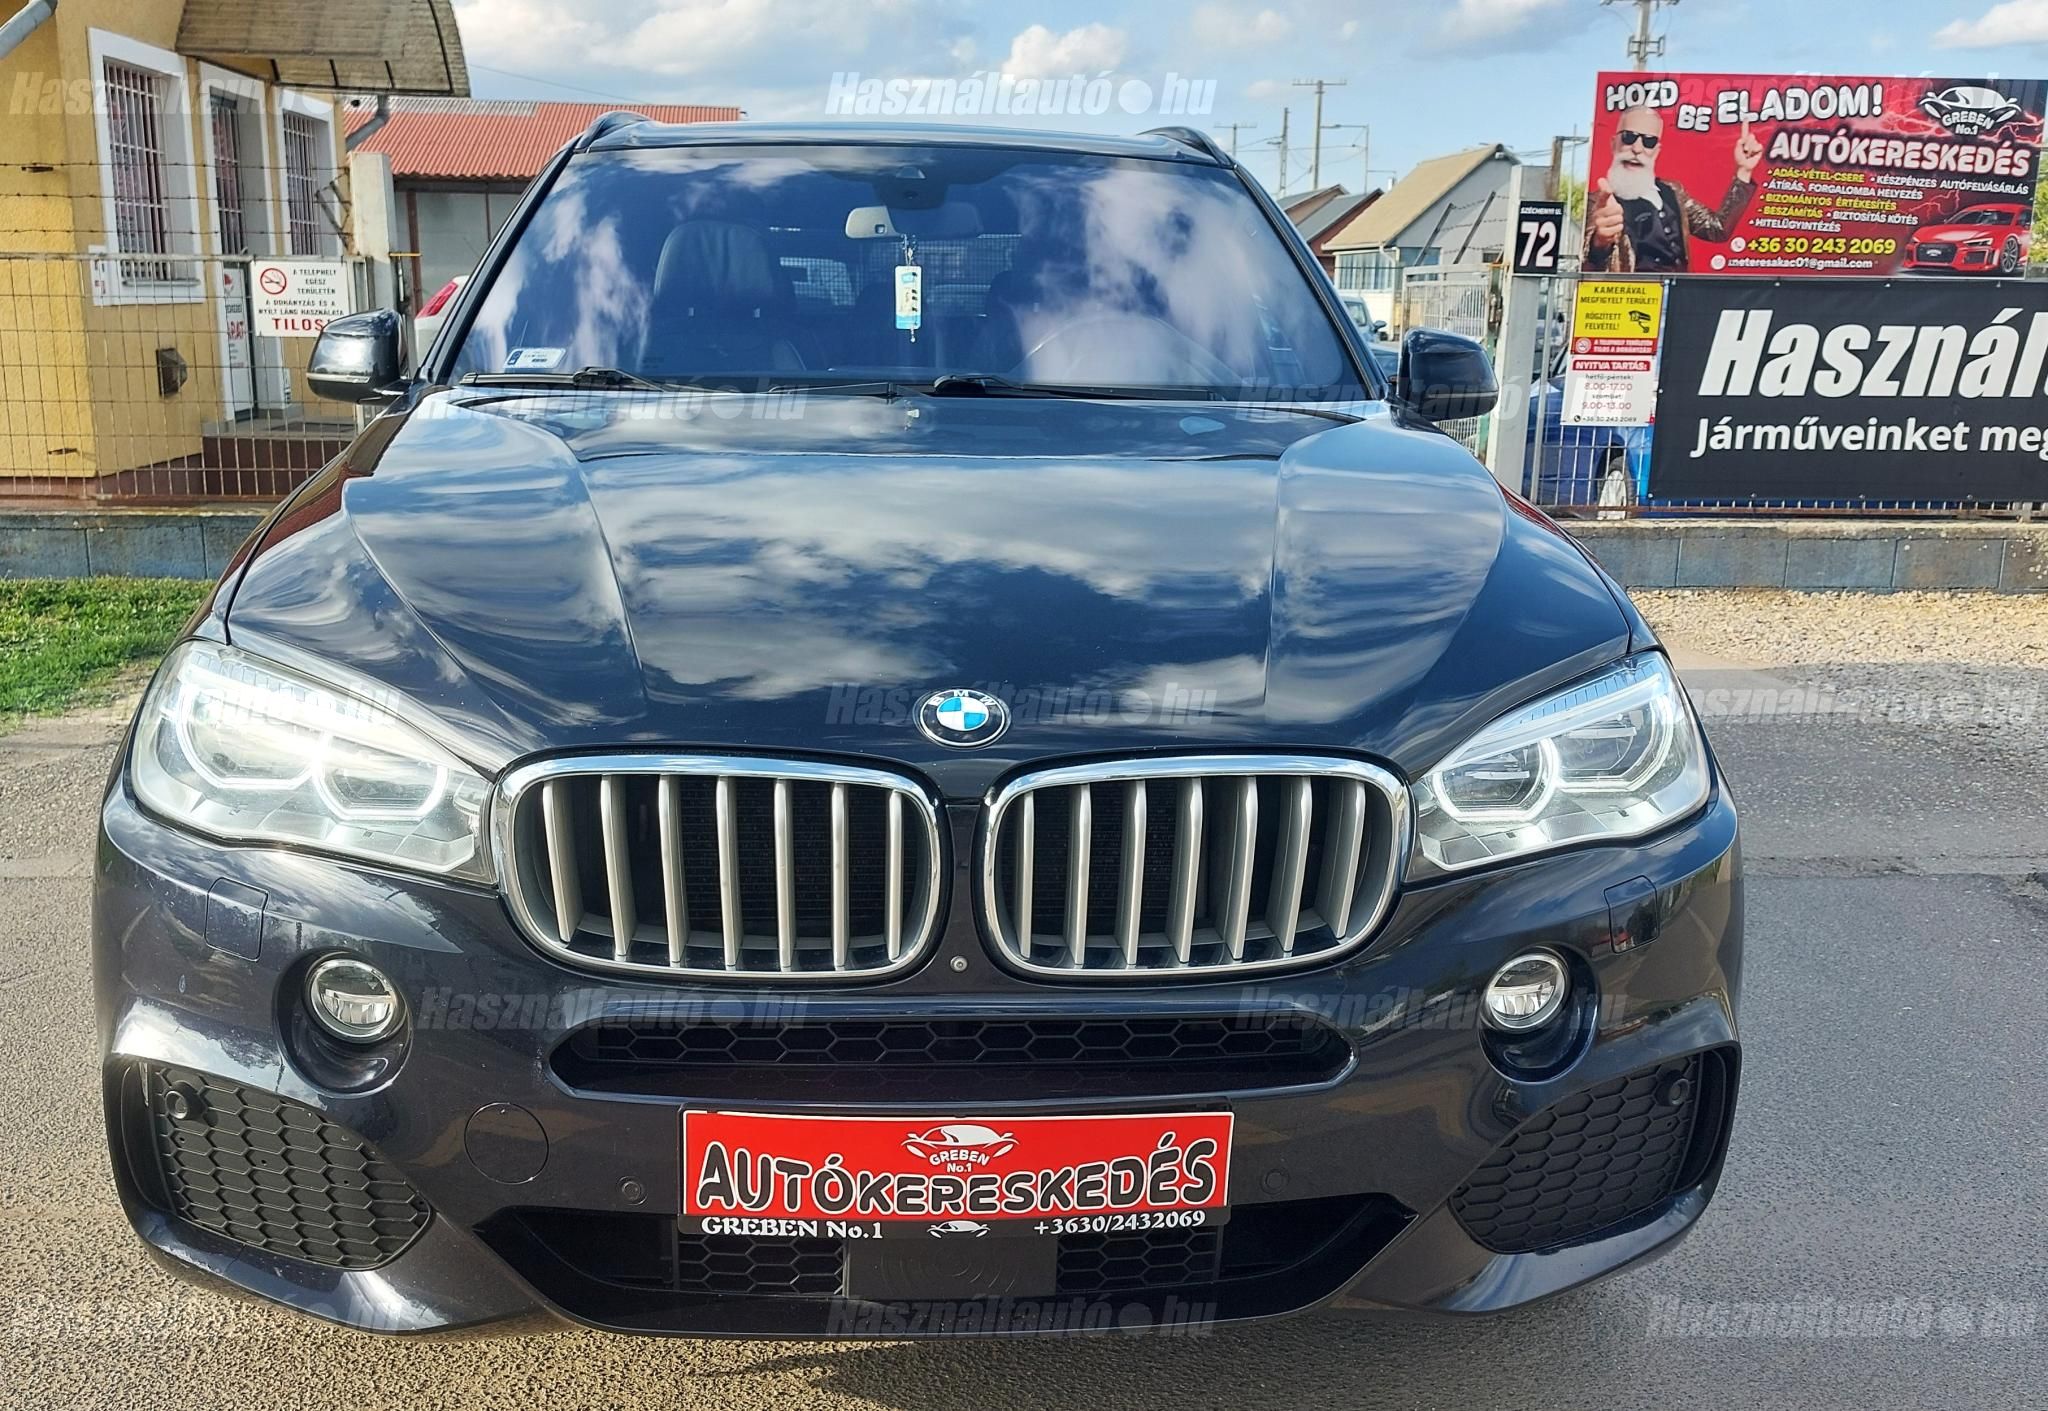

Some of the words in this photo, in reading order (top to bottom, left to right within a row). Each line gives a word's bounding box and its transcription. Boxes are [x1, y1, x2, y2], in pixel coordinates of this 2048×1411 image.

[1606, 80, 1678, 111] HOZD
[1717, 84, 1883, 124] ELADOM!
[1677, 104, 1712, 132] BE
[1942, 110, 1994, 130] GREBEN
[1955, 122, 1978, 136] No.1
[1770, 128, 2032, 177] AUTÓKERESKEDÉS
[1808, 183, 1876, 197] FORGALOMBA
[1878, 188, 1923, 200] HELYEZÉS
[1876, 175, 1937, 188] KÉSZPÉNZES
[1940, 179, 2030, 195] AUTÓFELVÁSÁRLÁS
[1765, 193, 1832, 206] BIZOMÁNYOS
[1835, 196, 1897, 211] ÉRTÉKESÍTÉS
[1763, 205, 1823, 218] BESZÁMÍTÁS
[1833, 210, 1886, 223] BIZTOSÍTÁS
[1887, 213, 1918, 226] KÖTÉS
[1519, 221, 1557, 267] 72
[1747, 238, 1781, 253] +36
[1784, 238, 1809, 253] 30
[1811, 238, 1846, 253] 243
[1849, 238, 1896, 255] 2069
[1594, 286, 1646, 295] KAMERÁVAL
[1580, 296, 1622, 304] MEGFIGYELT
[1626, 296, 1659, 305] TERÜLET!
[1585, 311, 1621, 320] RÖGZÍTETT
[1585, 321, 1620, 331] FELVÉTEL!
[1698, 308, 2048, 399] Használ
[1575, 361, 1610, 369] NYITVA
[1612, 360, 1647, 370] TARTÁS:
[1584, 382, 1633, 391] 8.00-17.00
[1690, 416, 1969, 458] Járműveinket
[928, 690, 997, 706] BMW
[929, 1149, 990, 1166] GREBEN
[696, 1131, 1217, 1215] AUTÓKERESKEDÉS
[946, 1162, 972, 1173] No.1
[701, 1216, 818, 1238] GREBEN
[825, 1220, 883, 1239] No.1
[1033, 1210, 1206, 1235] +3630/2432069
